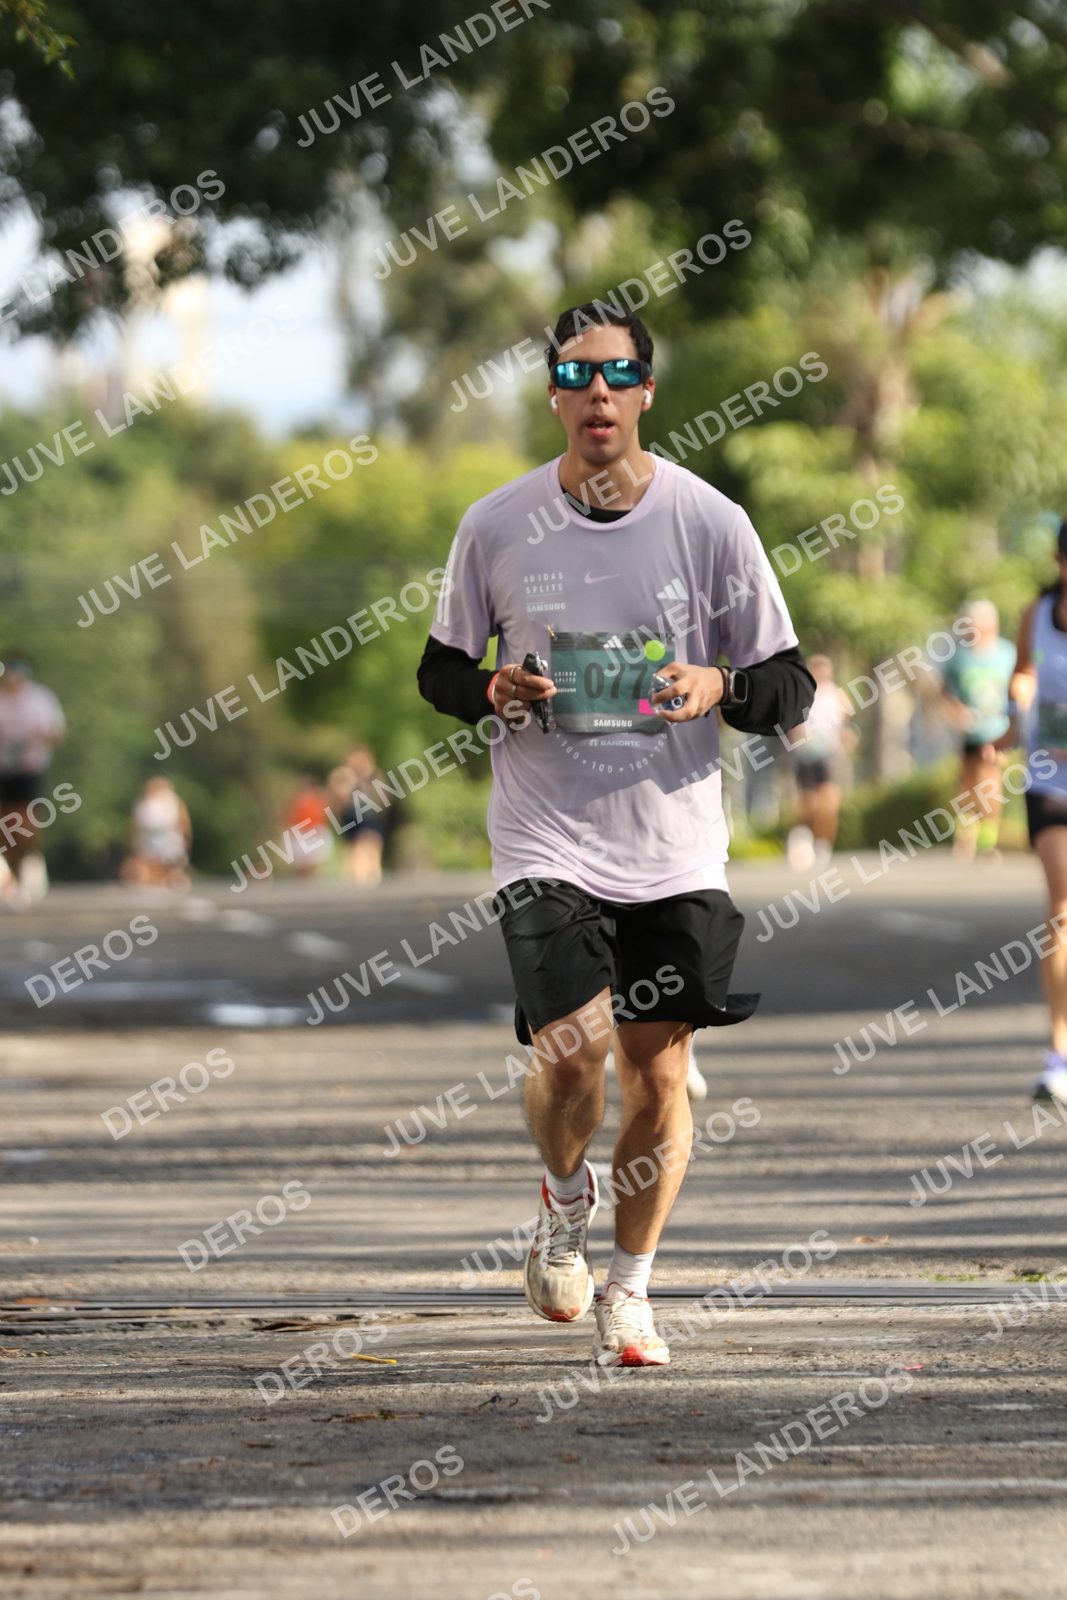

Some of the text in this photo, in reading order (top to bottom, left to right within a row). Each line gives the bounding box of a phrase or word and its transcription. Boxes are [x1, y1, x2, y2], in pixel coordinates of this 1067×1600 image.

[523, 572, 564, 583] ADIDAS
[526, 583, 563, 594] SPLITS
[527, 602, 566, 613] SAMSUNG
[593, 719, 633, 727] SAMSUNG
